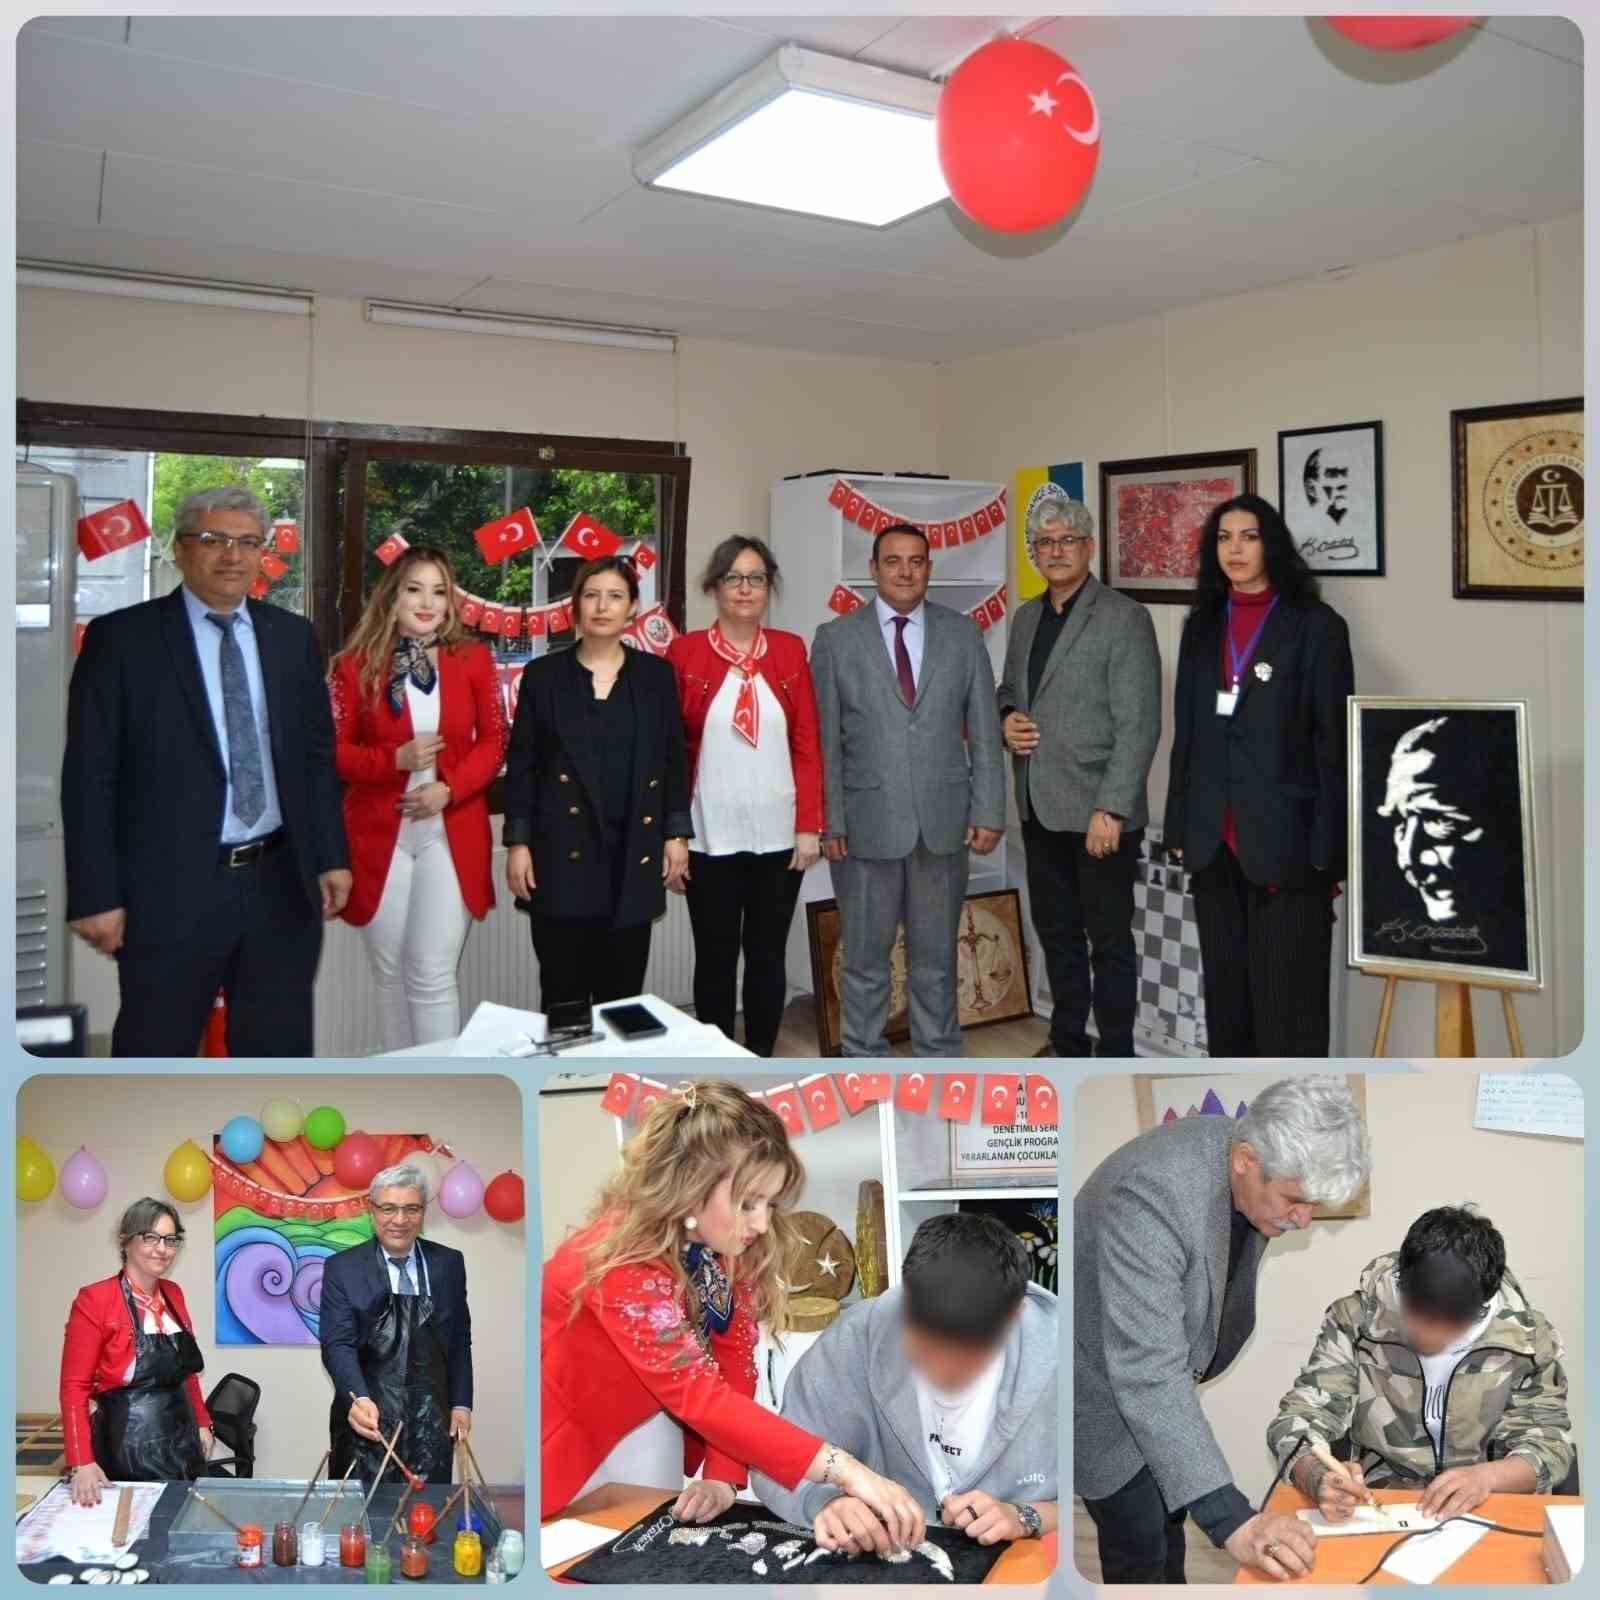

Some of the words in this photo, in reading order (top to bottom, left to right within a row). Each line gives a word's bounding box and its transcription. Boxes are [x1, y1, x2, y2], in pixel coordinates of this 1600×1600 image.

[987, 1137, 1022, 1148] GENÇLİK
[961, 1152, 1015, 1161] YARARLANAN
[1017, 1150, 1058, 1162] ÇOCUKLA
